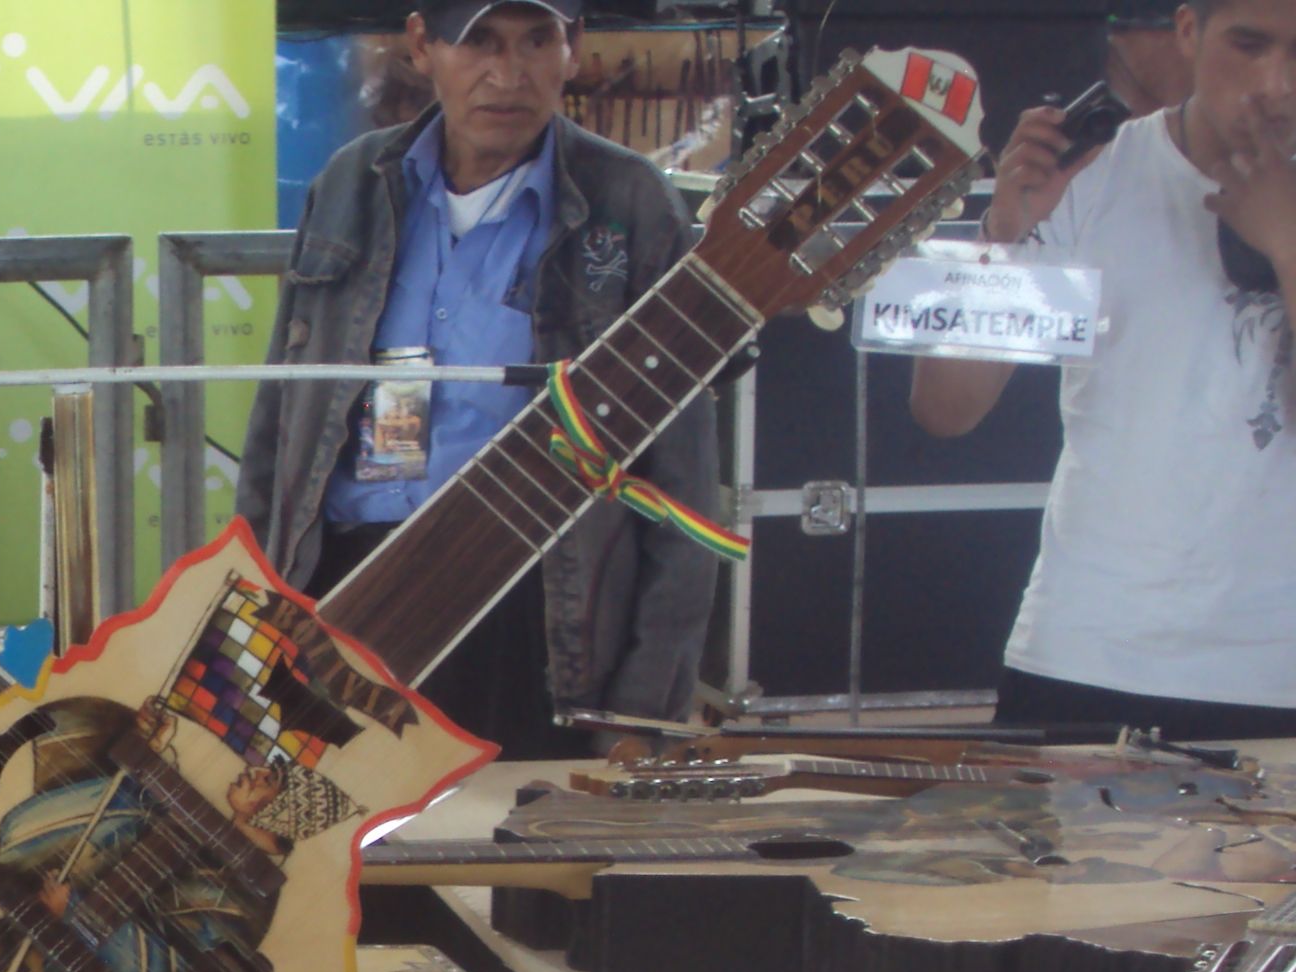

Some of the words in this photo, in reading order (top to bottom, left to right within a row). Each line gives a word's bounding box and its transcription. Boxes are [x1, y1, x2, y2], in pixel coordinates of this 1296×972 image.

[25, 63, 251, 121] VIVA
[787, 136, 895, 232] PERU
[873, 303, 1088, 342] KIMSATEMPLE
